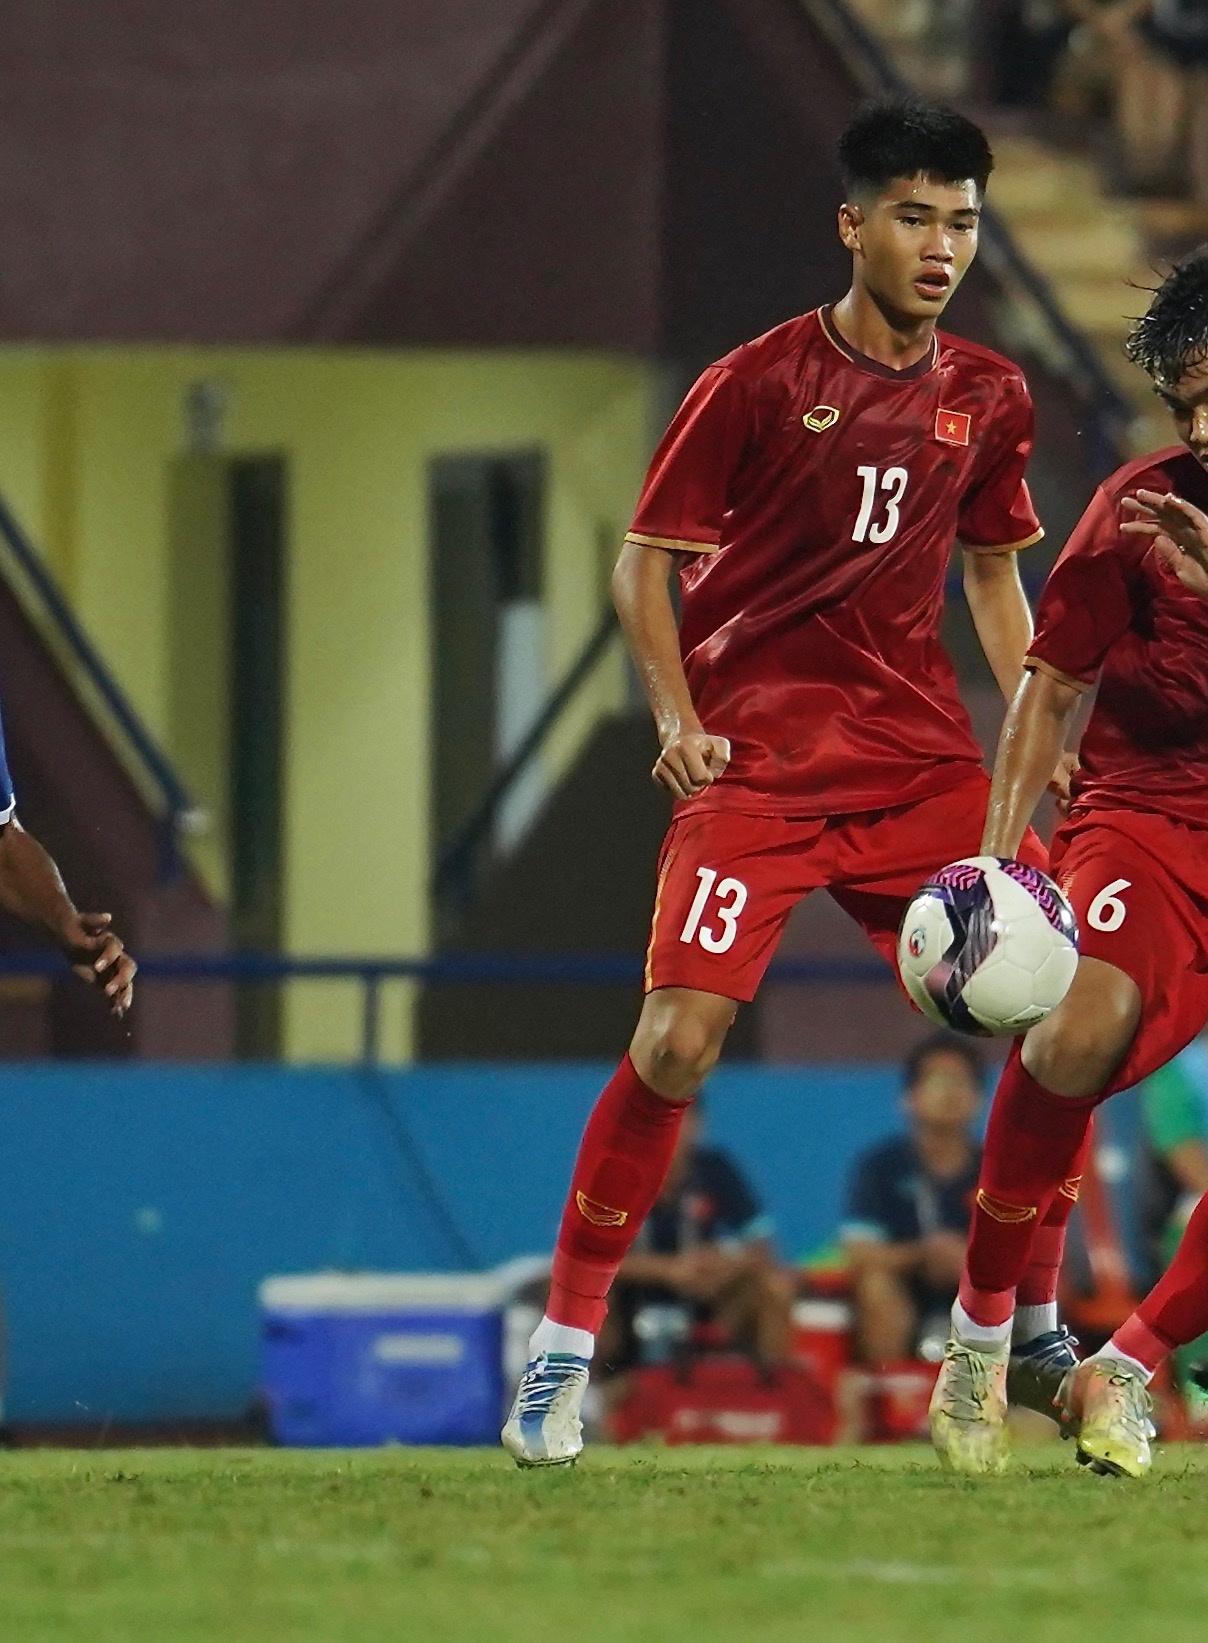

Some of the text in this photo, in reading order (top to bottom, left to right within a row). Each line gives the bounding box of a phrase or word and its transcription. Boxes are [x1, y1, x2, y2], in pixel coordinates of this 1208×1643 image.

[852, 466, 908, 543] 13
[680, 866, 748, 954] 13
[1087, 878, 1132, 932] 6
